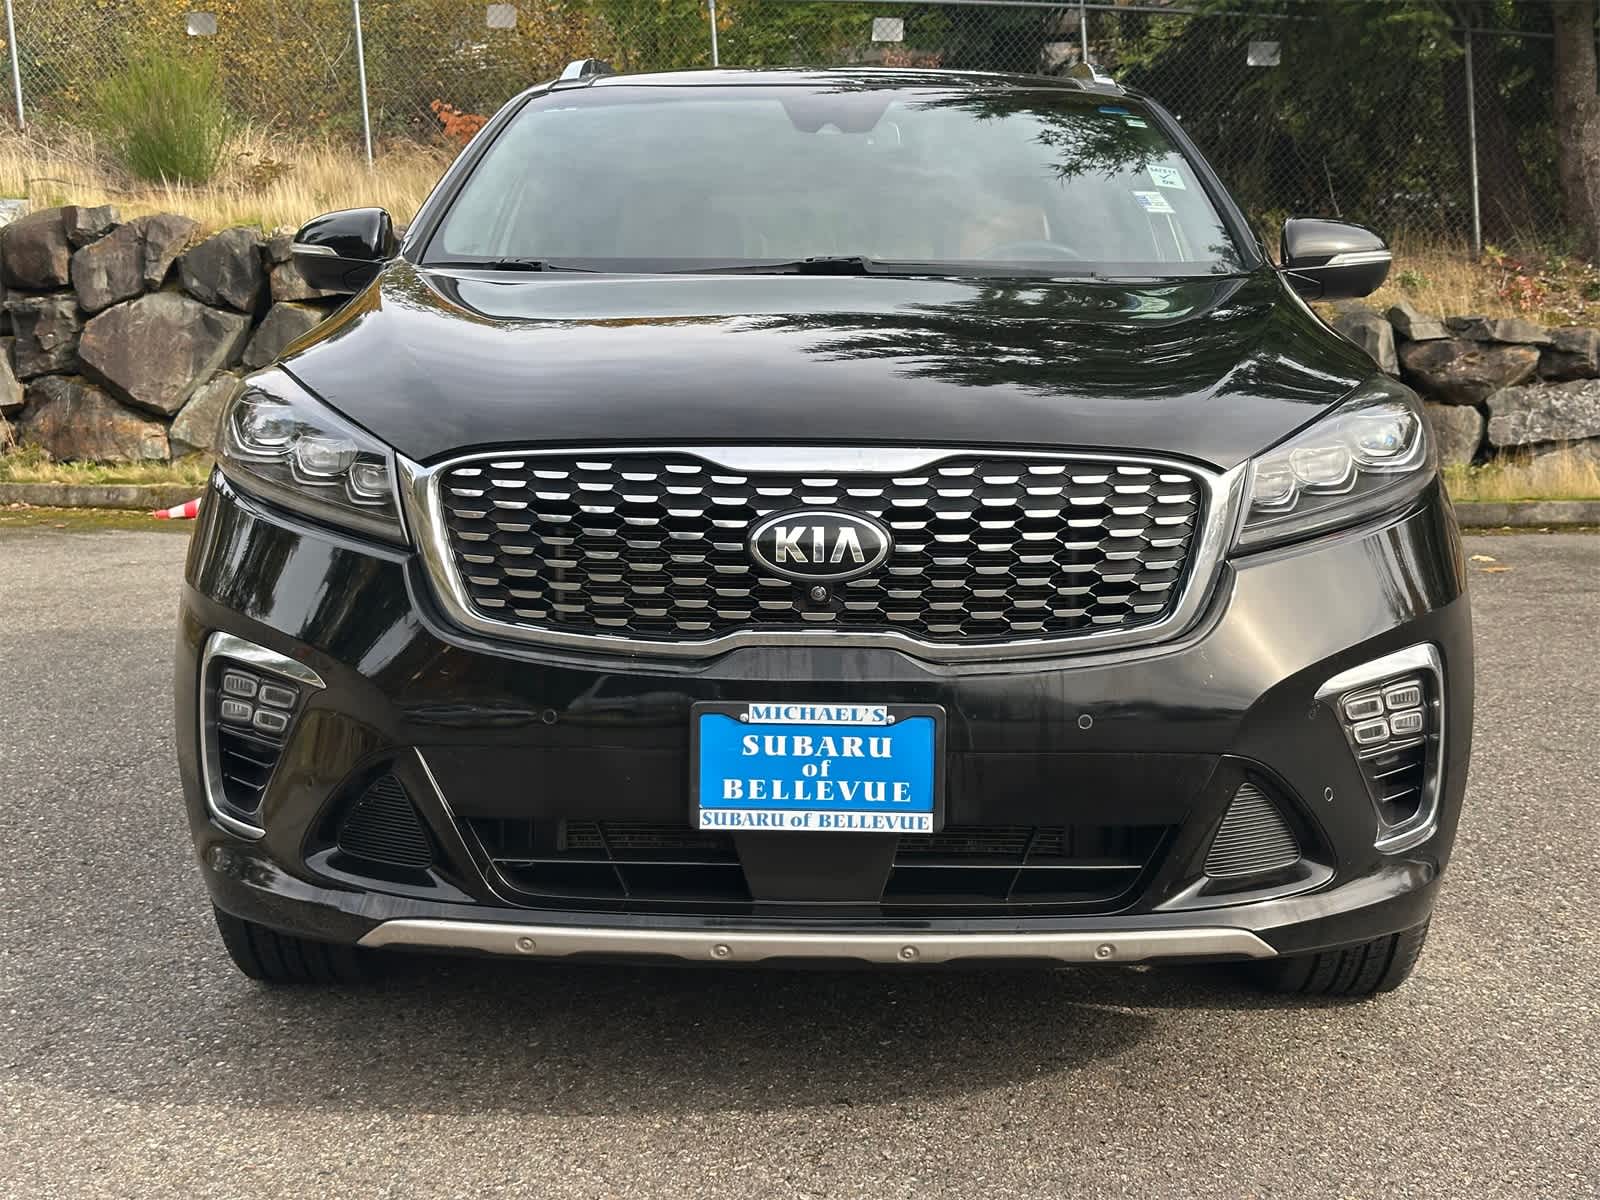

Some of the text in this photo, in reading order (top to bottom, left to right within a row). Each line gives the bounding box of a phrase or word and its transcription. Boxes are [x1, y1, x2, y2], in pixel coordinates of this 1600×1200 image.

[774, 527, 865, 563] KIA
[751, 706, 885, 722] MICHAEL'S
[742, 735, 893, 757] SUBARU
[802, 760, 831, 777] of
[722, 778, 911, 802] BELLEVUE
[701, 812, 929, 830] SUBARU of BELLEVUE
